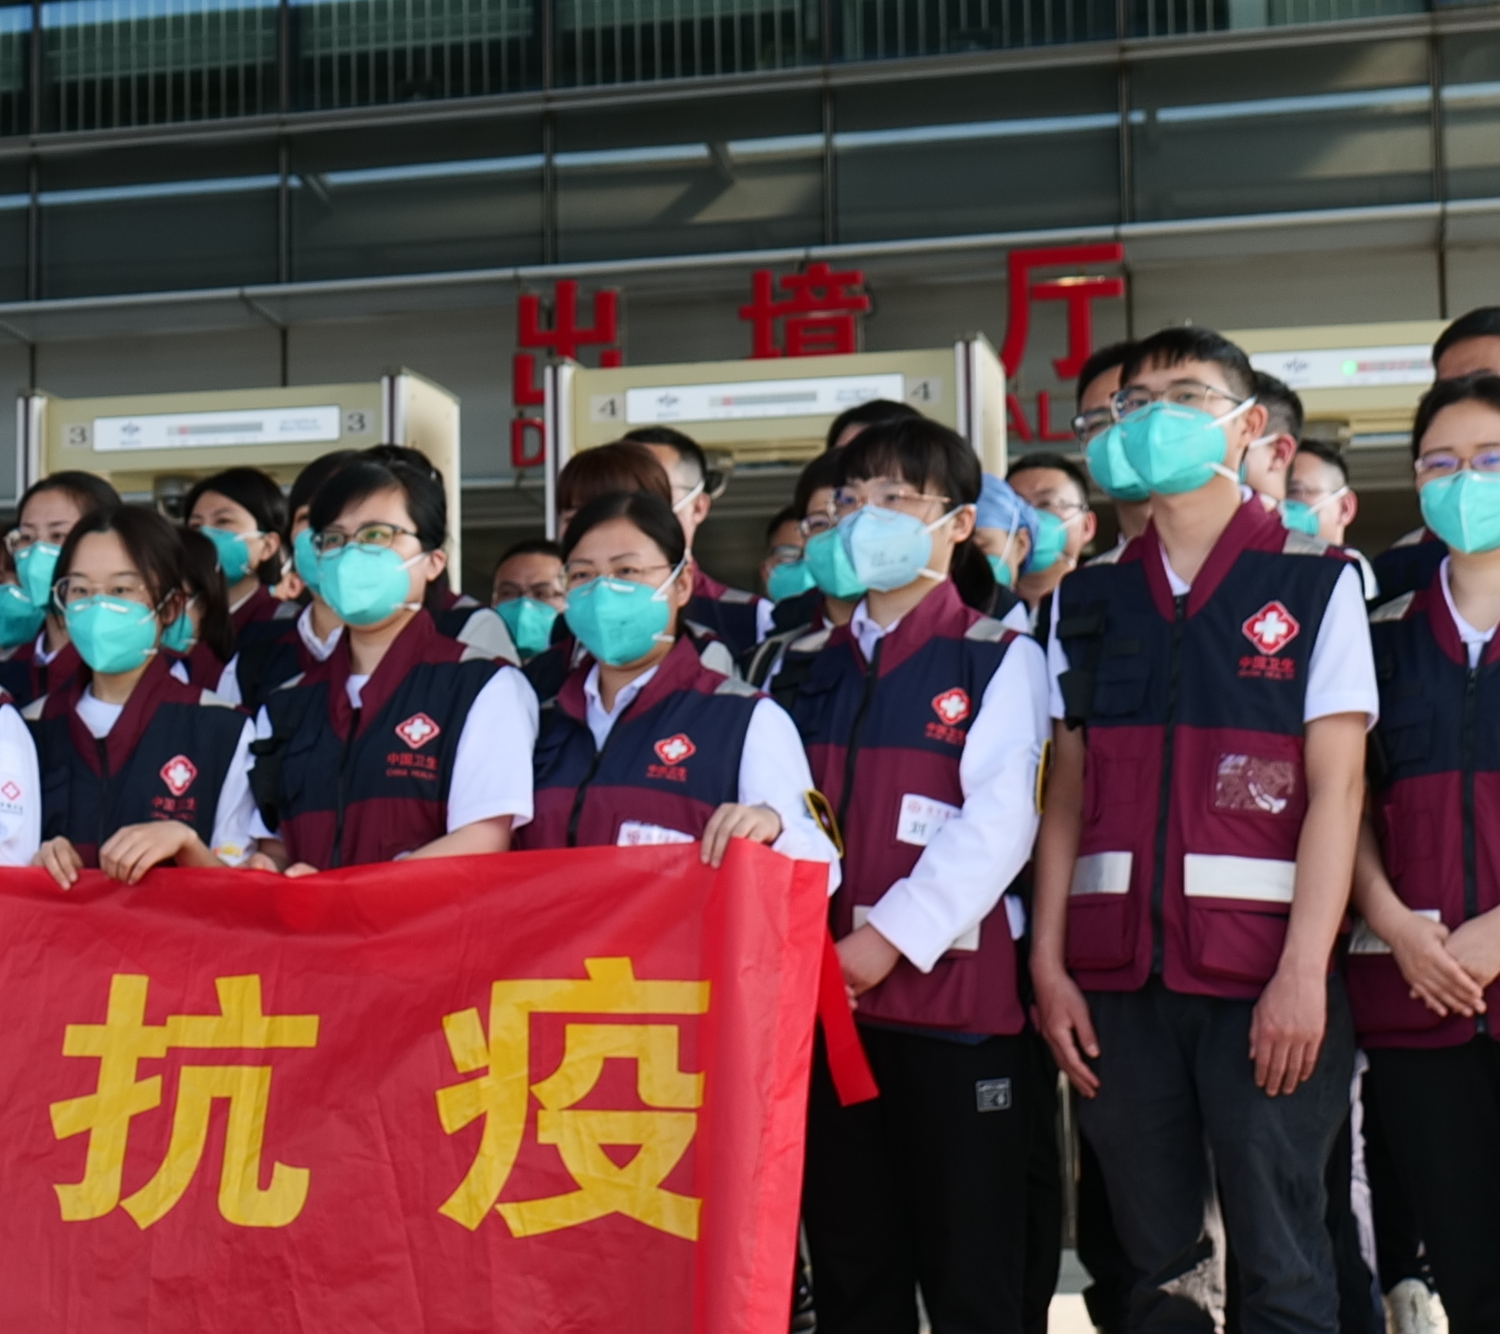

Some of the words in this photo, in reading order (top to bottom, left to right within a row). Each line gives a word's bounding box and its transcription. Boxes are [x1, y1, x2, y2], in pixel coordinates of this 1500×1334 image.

[512, 242, 1124, 406] 出境厅
[911, 380, 931, 401] 4
[599, 399, 618, 418] 4
[347, 412, 366, 433] 3
[69, 425, 88, 445] 3
